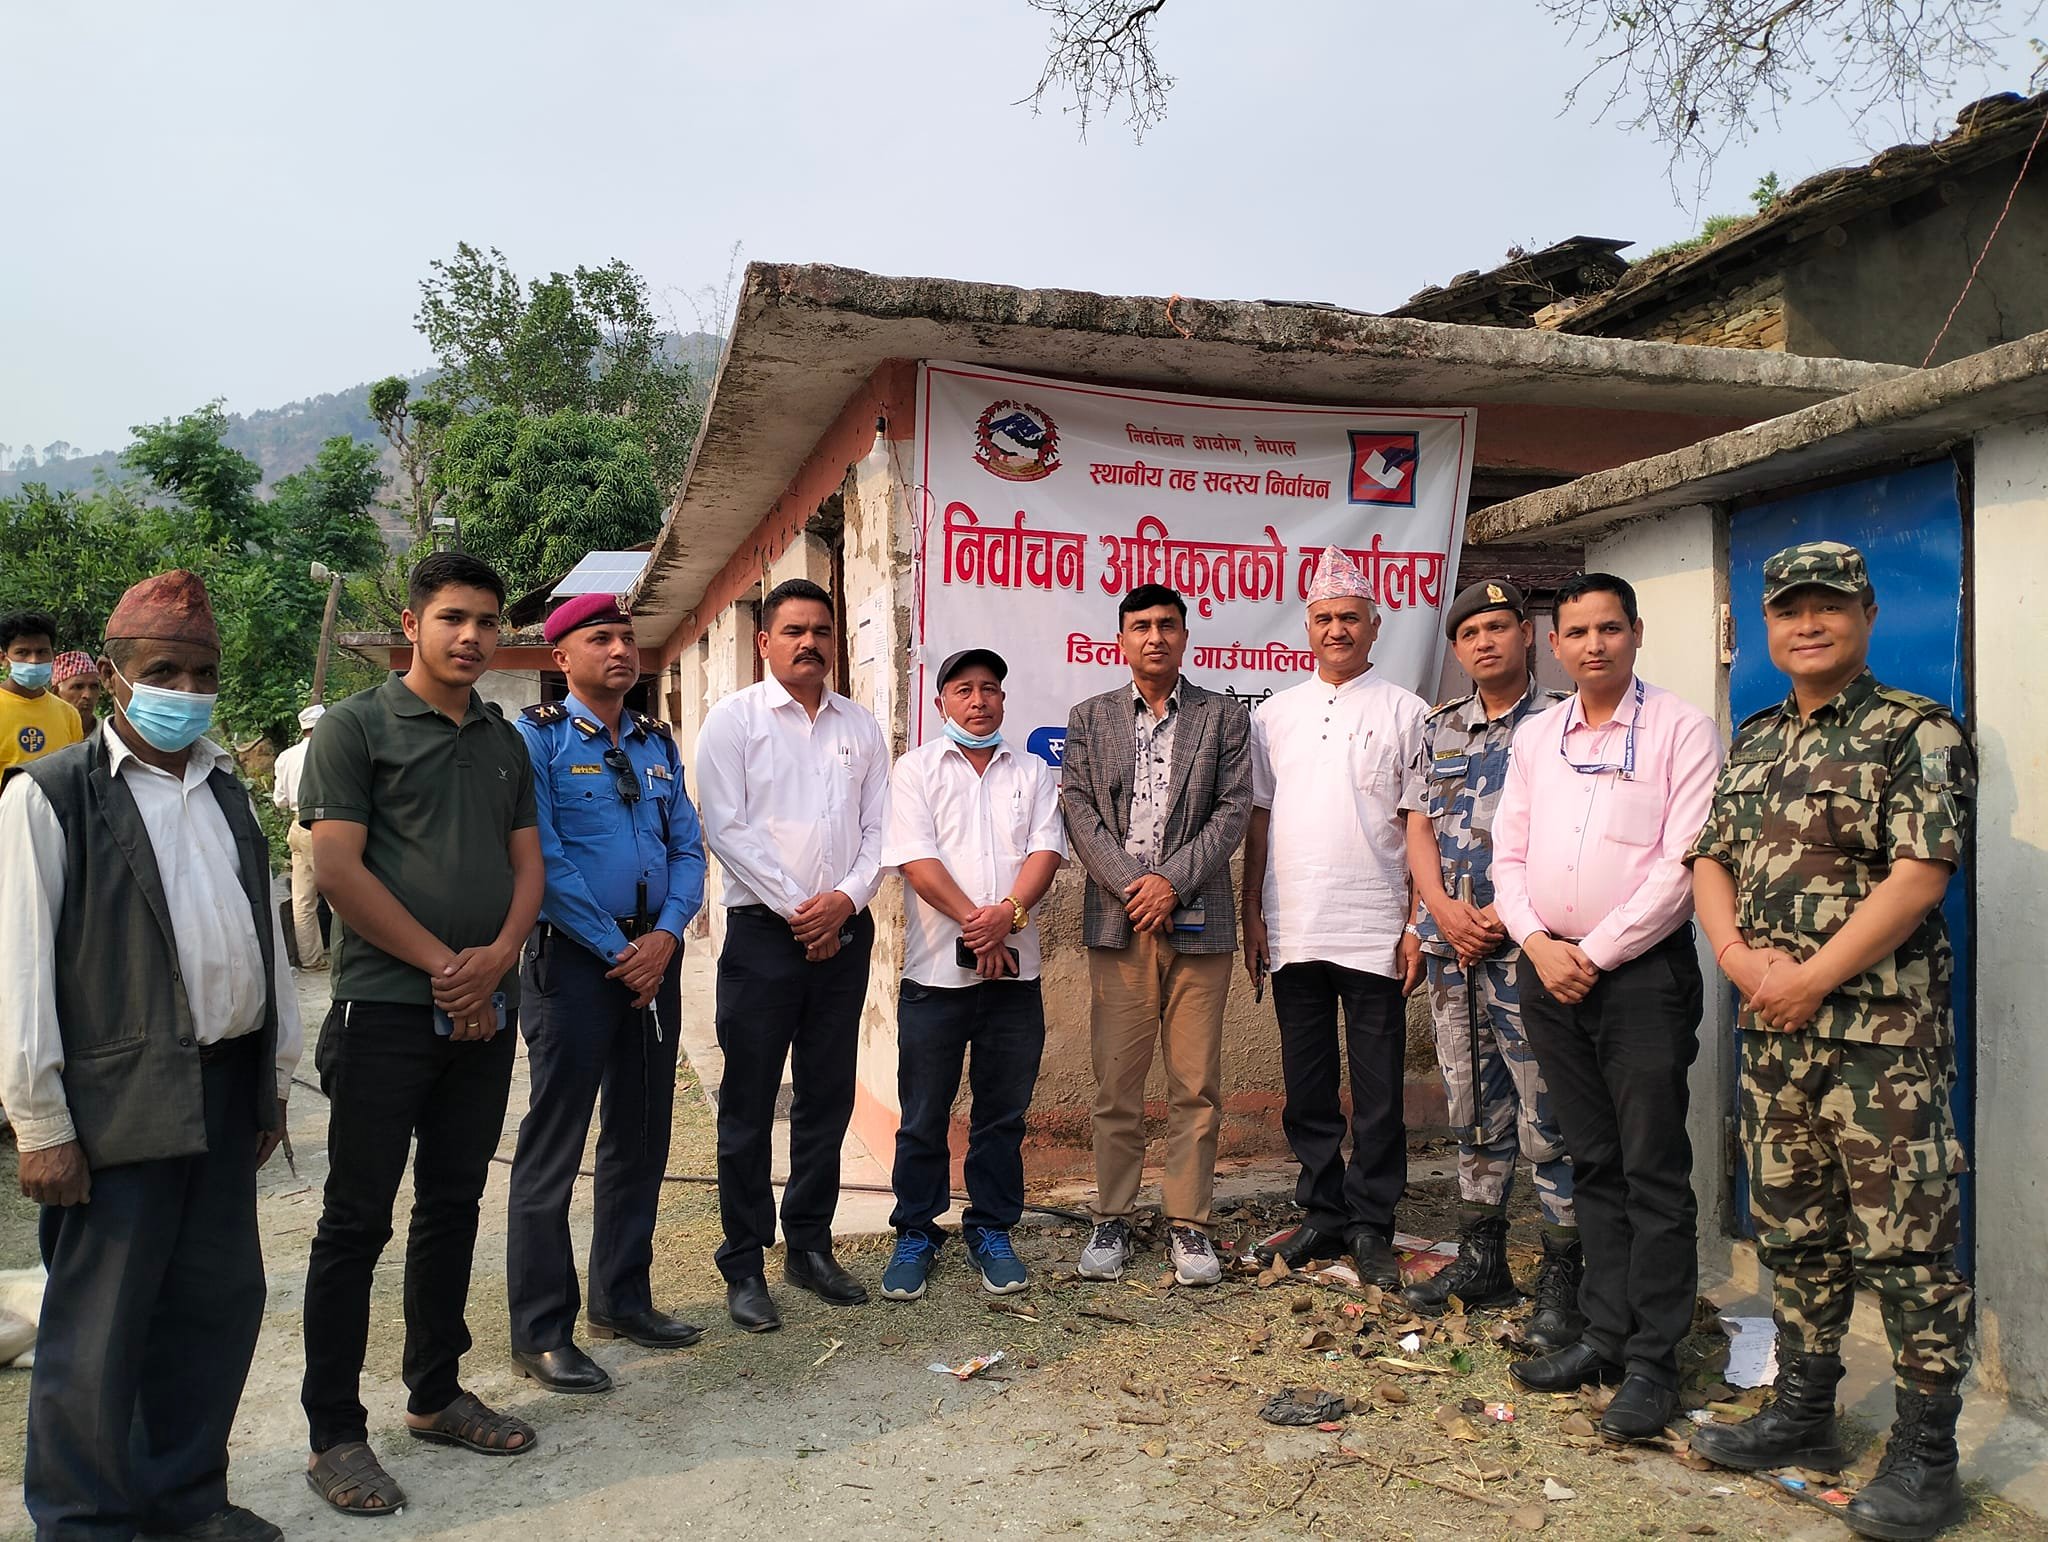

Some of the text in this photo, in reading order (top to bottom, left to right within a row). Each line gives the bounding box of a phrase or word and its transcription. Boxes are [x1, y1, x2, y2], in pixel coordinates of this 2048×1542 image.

[1125, 423, 1185, 448] निर्वाचन
[1254, 435, 1297, 457] नेपाल
[1090, 461, 1331, 499] स्थानीय तह सदस्य निर्वाचन
[943, 501, 1088, 593] निर्वाचन
[1099, 515, 1288, 618] अधिकृतको
